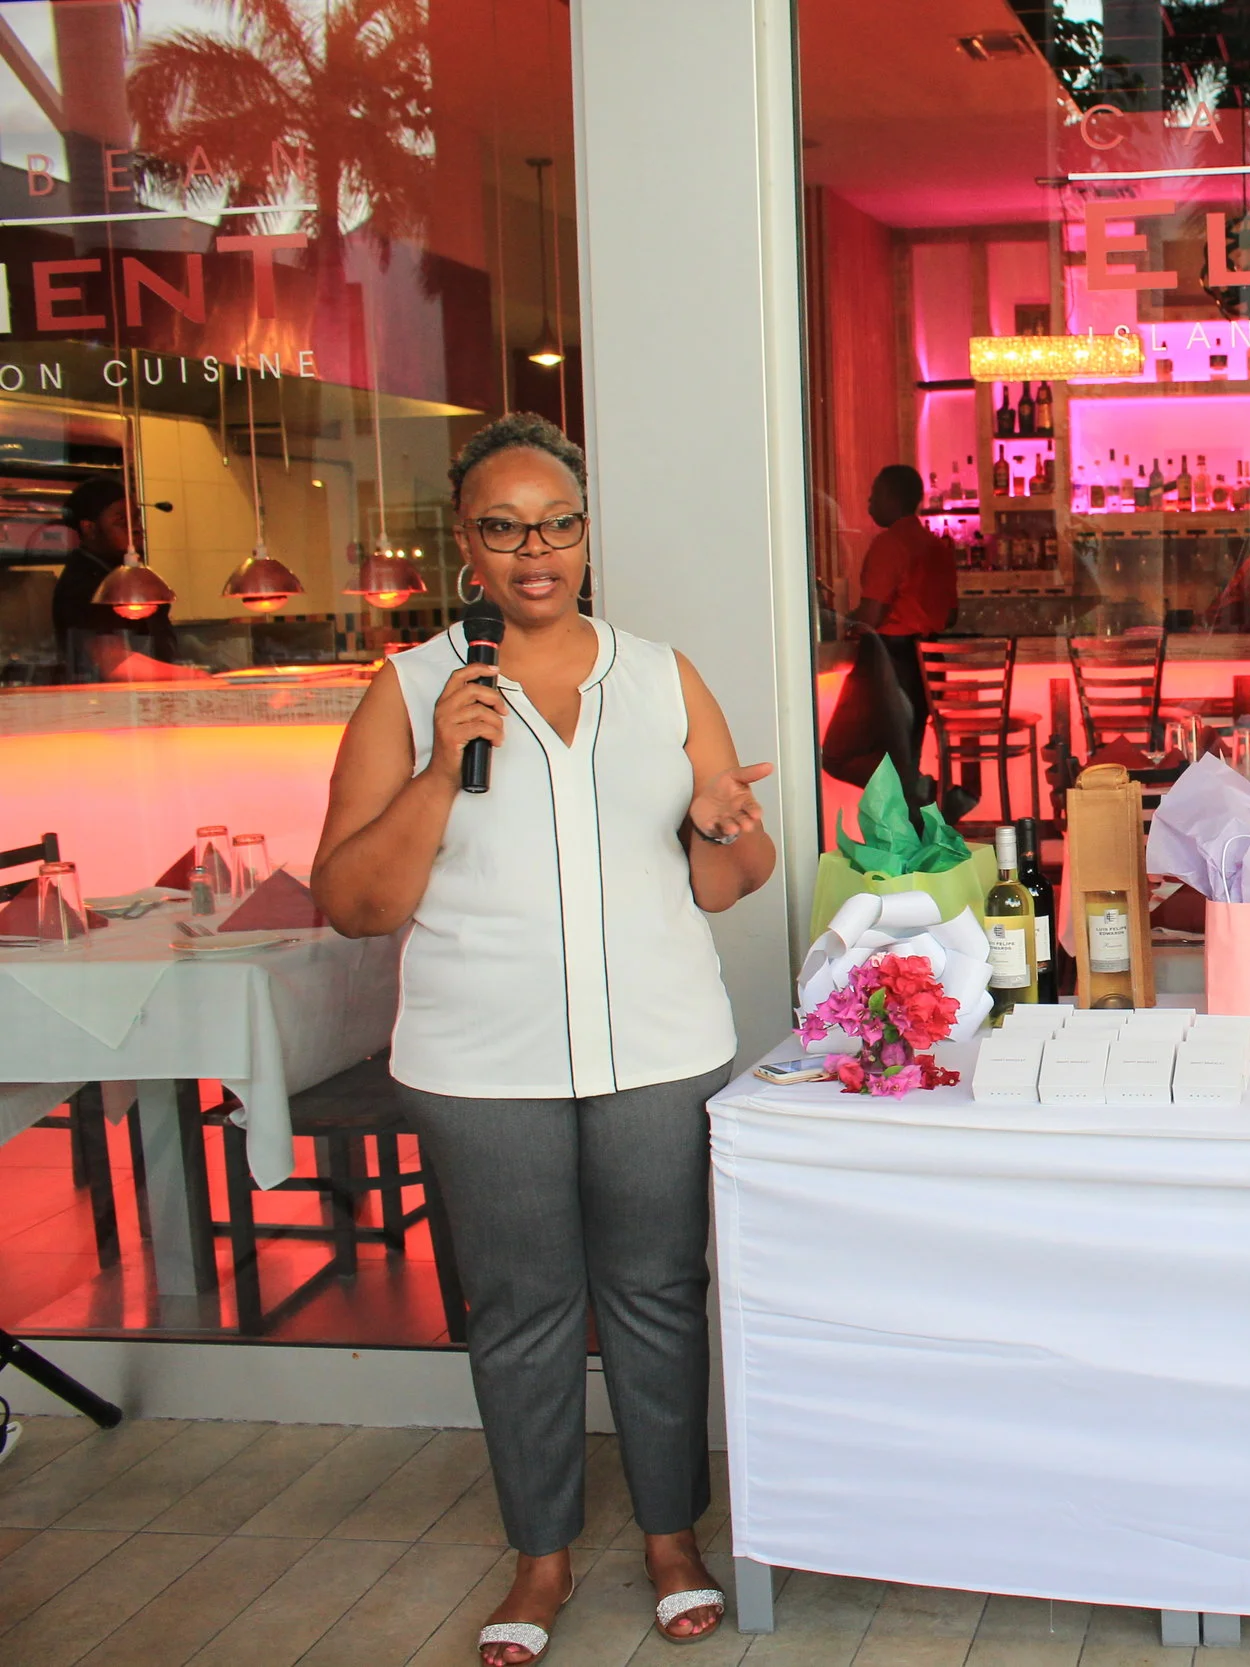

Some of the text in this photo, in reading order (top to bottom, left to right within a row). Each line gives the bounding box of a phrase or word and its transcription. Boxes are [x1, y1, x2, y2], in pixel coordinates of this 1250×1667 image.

[27, 140, 308, 197] BEAN
[0, 232, 308, 334] ENT
[103, 349, 316, 387] CUISINE
